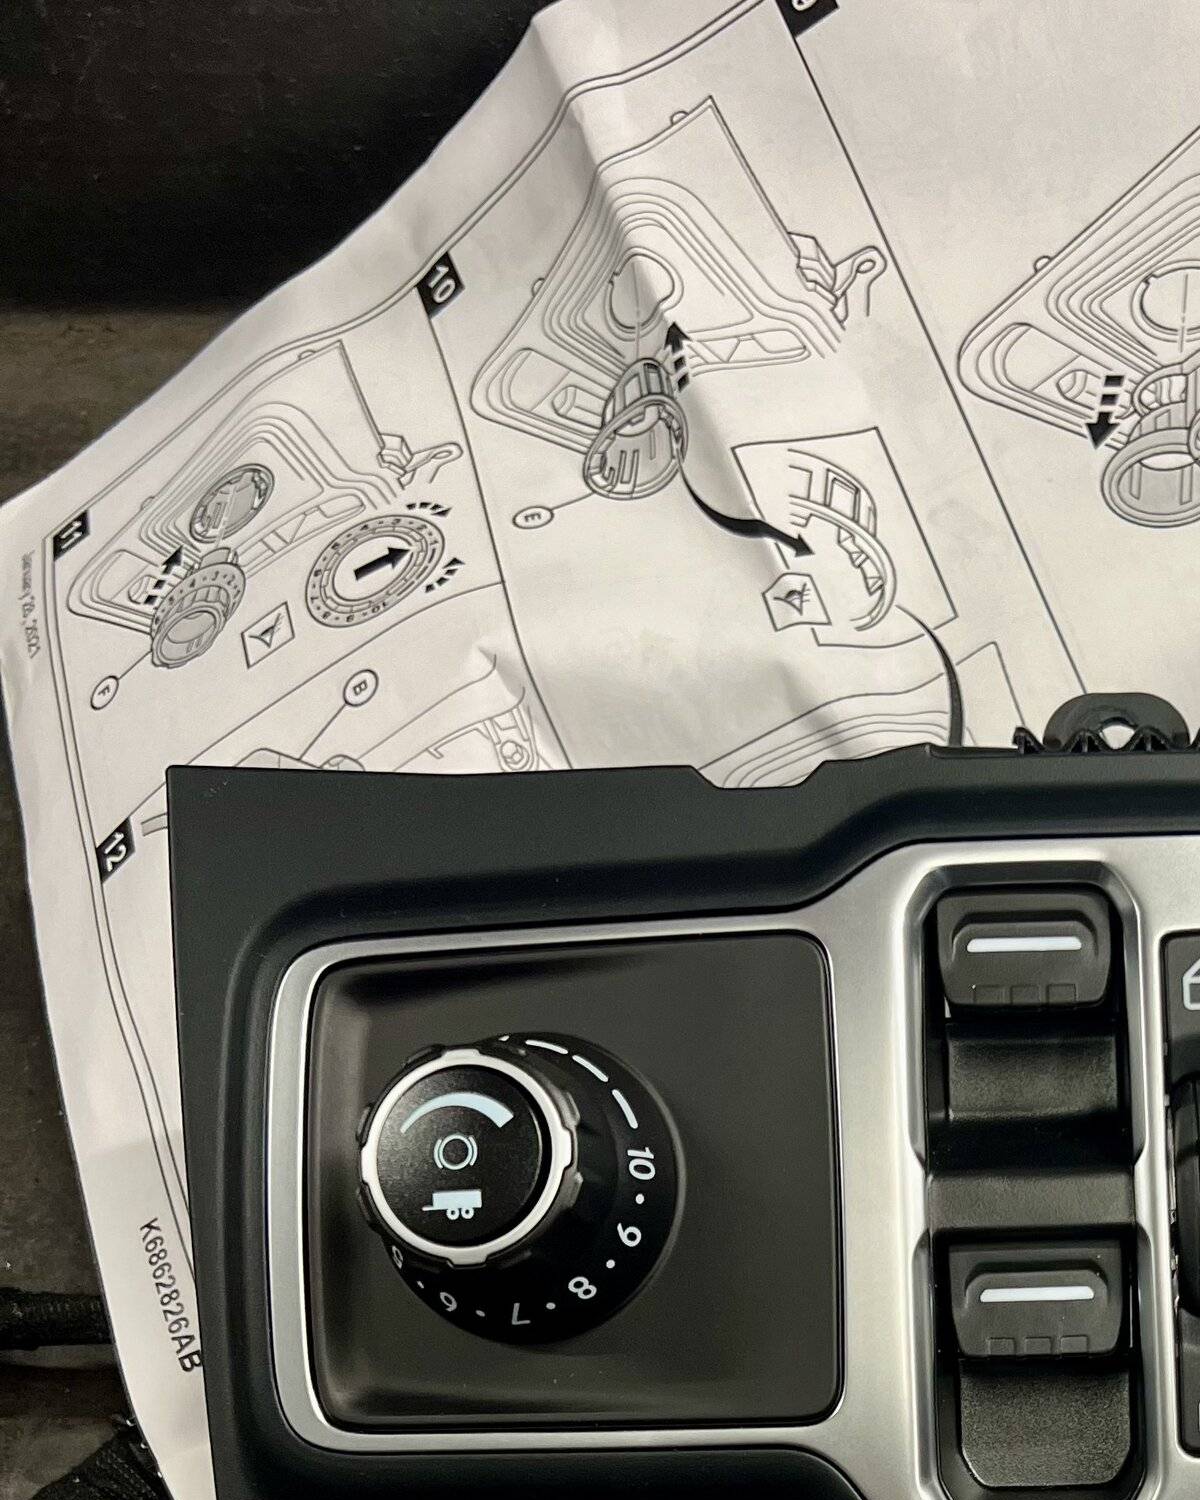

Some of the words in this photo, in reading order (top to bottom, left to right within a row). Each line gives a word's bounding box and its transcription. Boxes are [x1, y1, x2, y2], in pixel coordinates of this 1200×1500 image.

[428, 265, 456, 304] 10
[60, 520, 82, 549] 11
[352, 679, 368, 696] B
[103, 831, 127, 872] 12
[626, 1146, 656, 1181] 10
[617, 1222, 643, 1248] 9
[140, 1217, 203, 1373] K6862826AB
[567, 1275, 597, 1300] 8
[511, 1302, 531, 1326] 7
